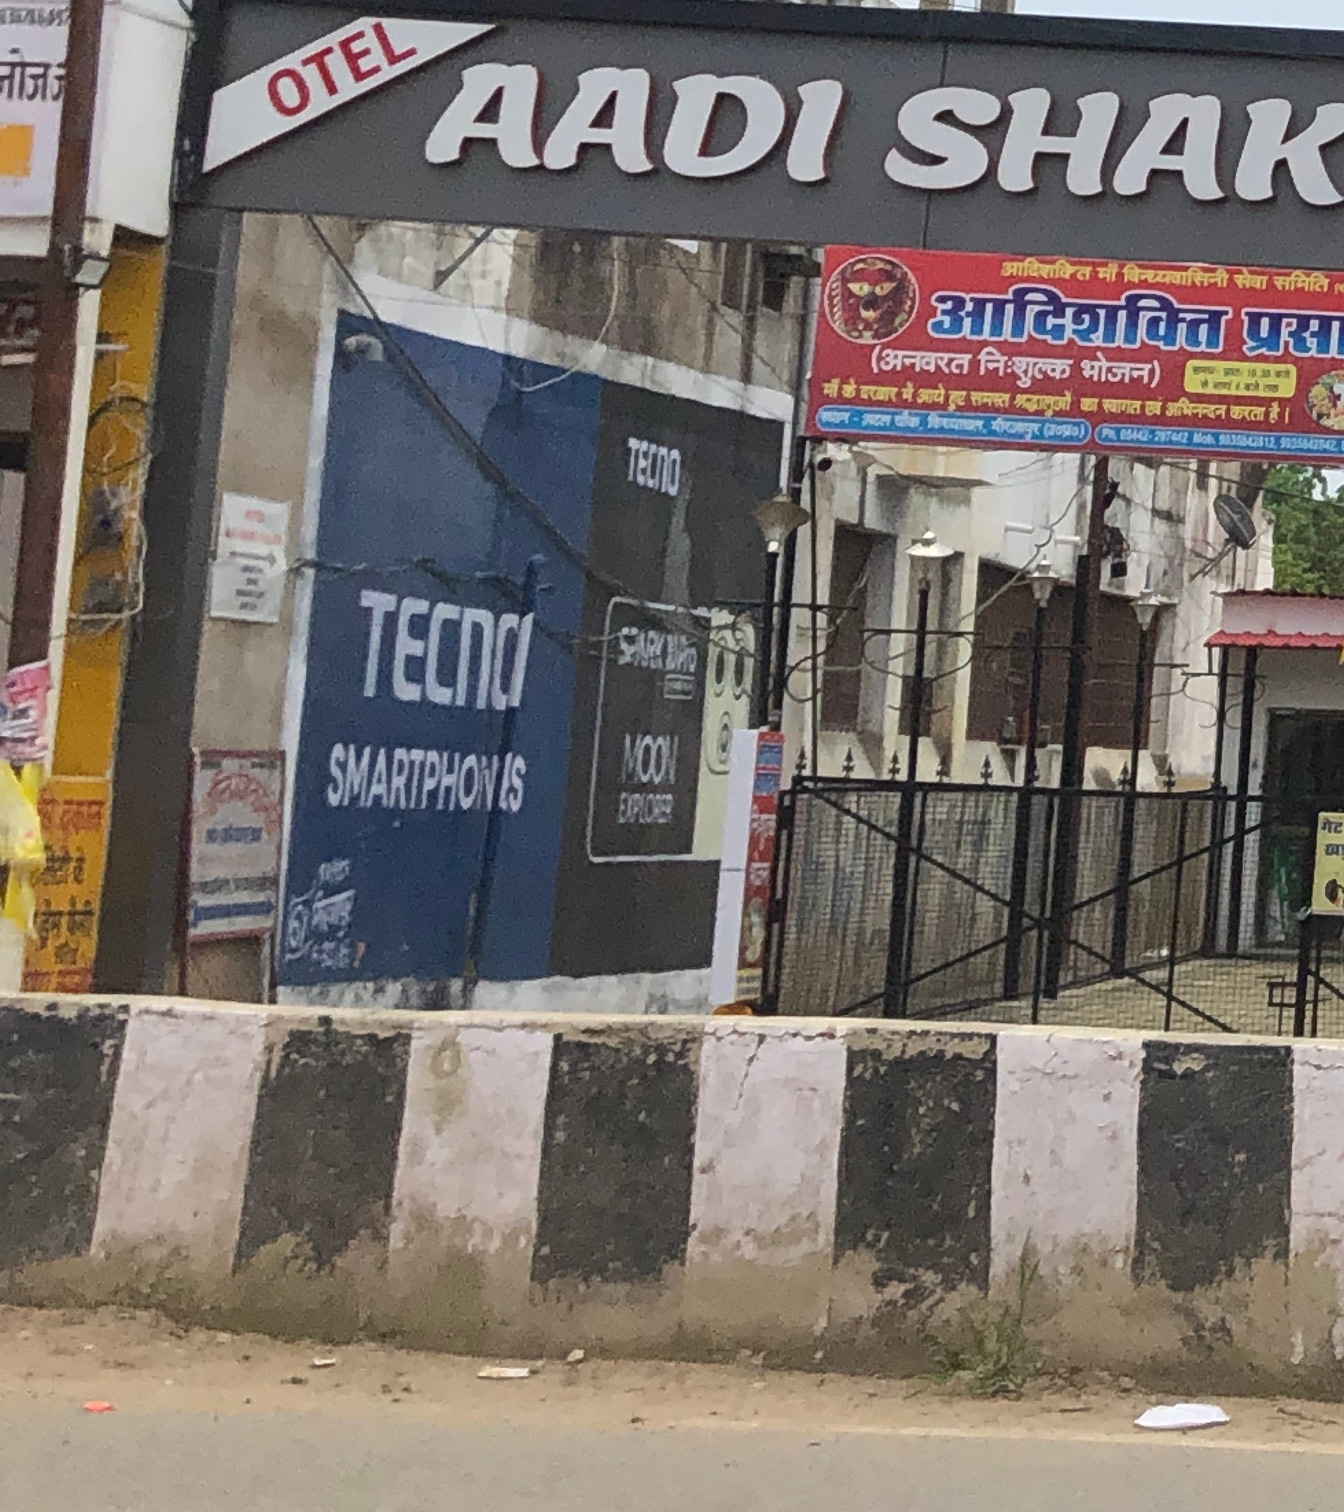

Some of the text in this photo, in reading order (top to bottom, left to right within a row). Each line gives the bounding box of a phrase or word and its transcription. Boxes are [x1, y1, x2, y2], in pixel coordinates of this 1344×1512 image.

[266, 20, 418, 118] OTEL
[424, 62, 844, 183] AADI
[1233, 269, 1268, 291] सेवा
[1273, 270, 1330, 293] समिति
[928, 284, 1232, 352] आदिशक्ति
[870, 345, 972, 376] (अनवरत
[1079, 352, 1161, 388] भोजन)
[619, 732, 680, 785] MOON
